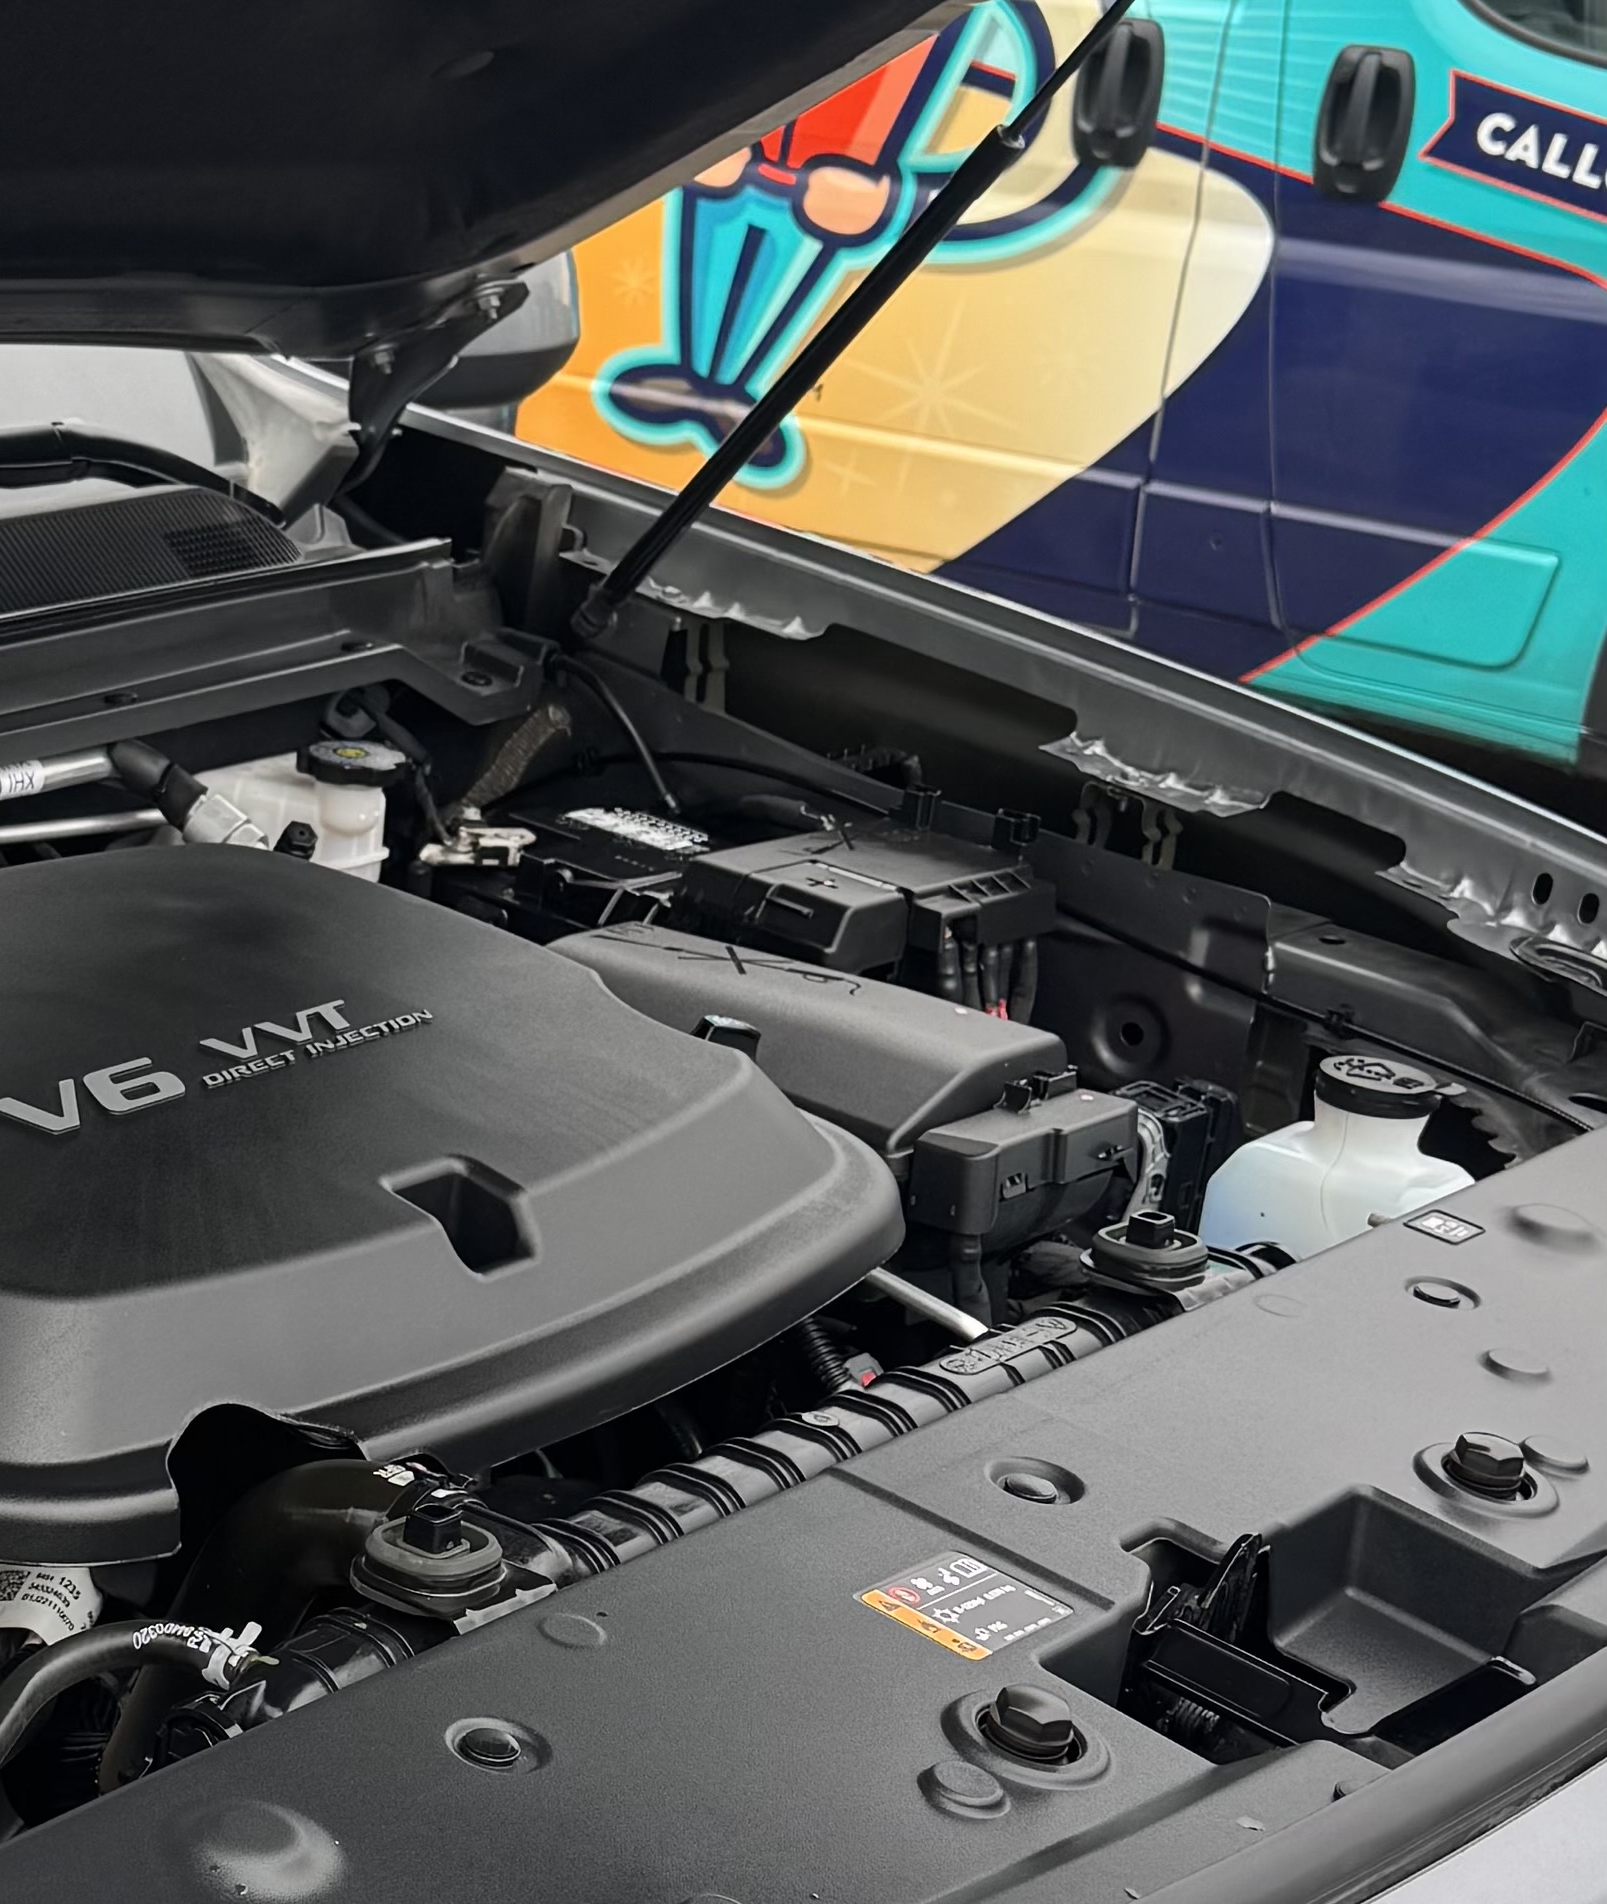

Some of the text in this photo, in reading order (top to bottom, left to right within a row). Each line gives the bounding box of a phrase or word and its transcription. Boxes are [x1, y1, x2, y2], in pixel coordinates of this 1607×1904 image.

[1477, 111, 1607, 190] CALL
[199, 999, 350, 1061] VVT
[202, 1008, 434, 1089] DIRECT INJECTION
